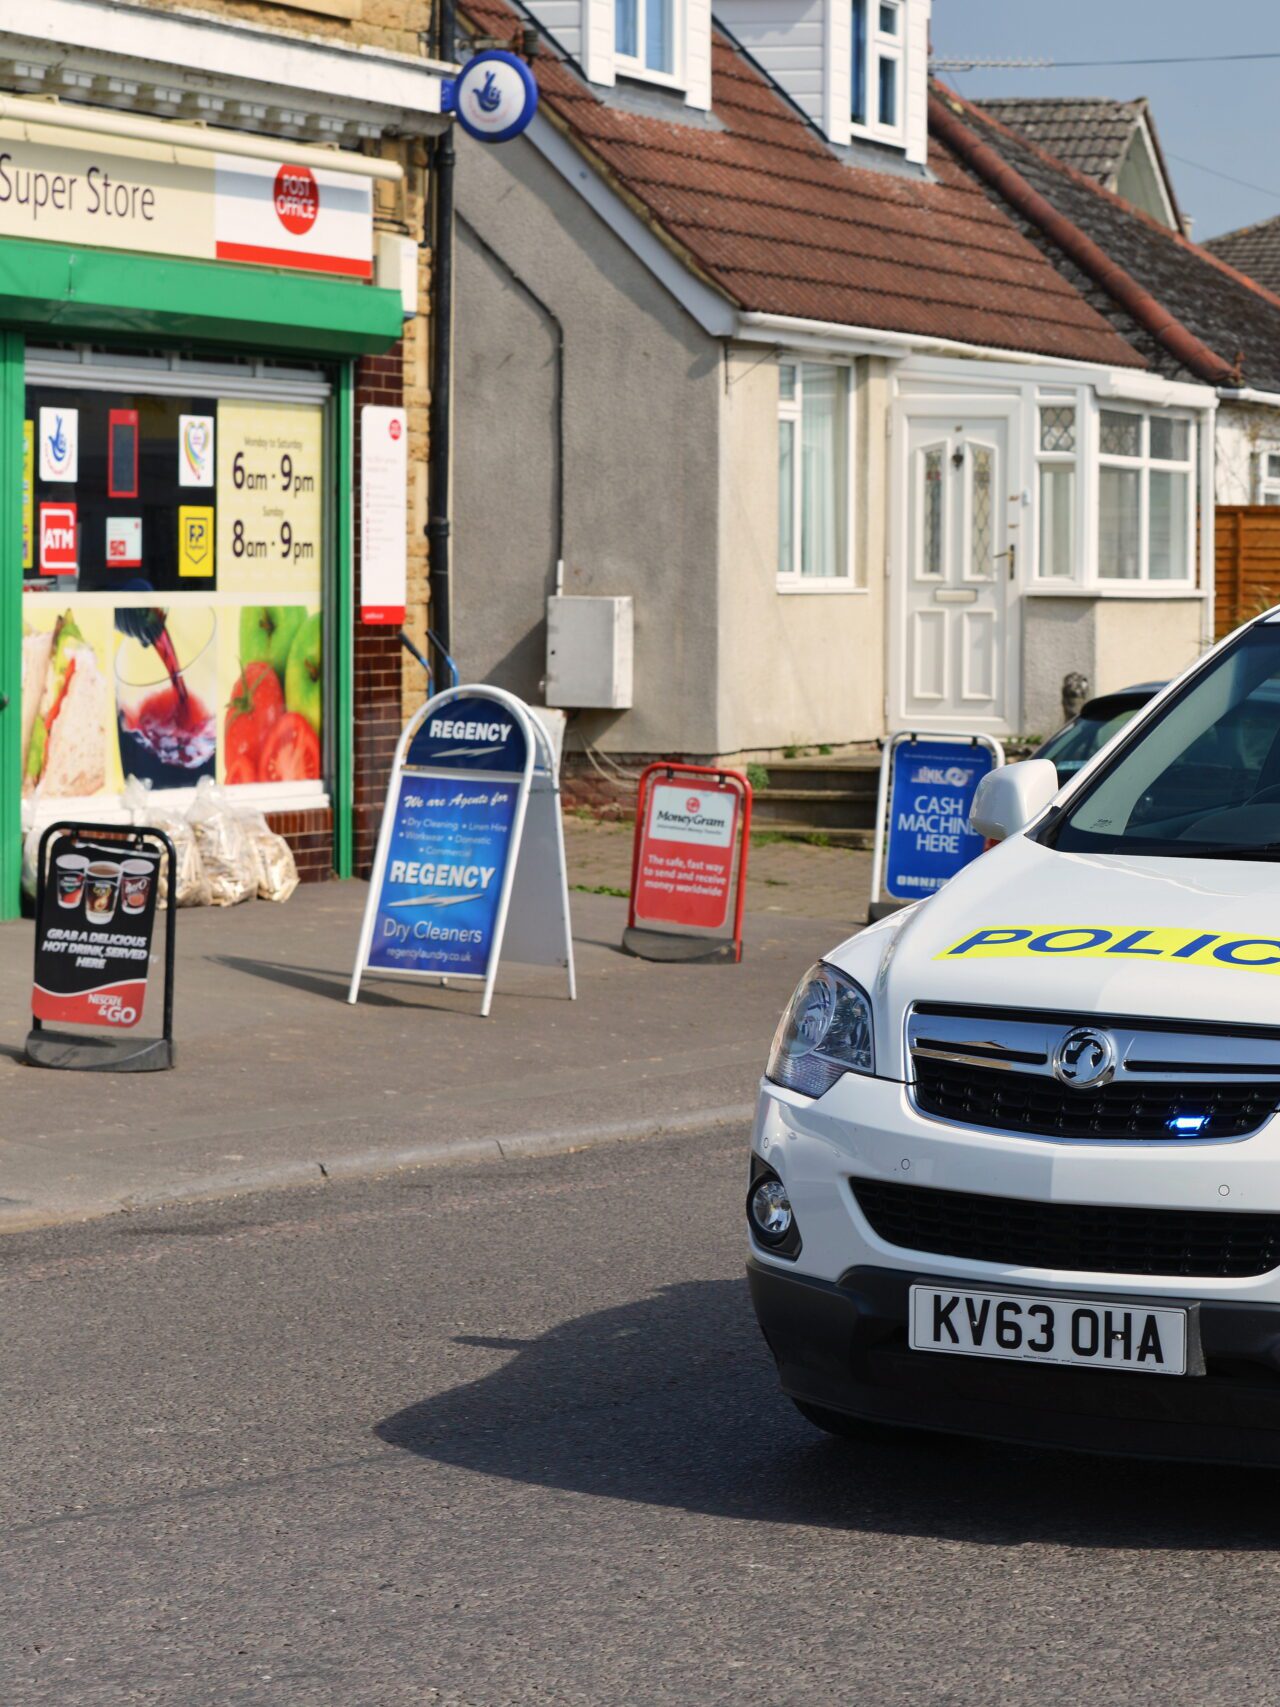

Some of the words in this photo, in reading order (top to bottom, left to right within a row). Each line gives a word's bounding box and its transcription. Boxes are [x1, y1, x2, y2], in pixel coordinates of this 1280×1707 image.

[0, 153, 77, 220] Super
[87, 166, 155, 221] Store
[282, 174, 311, 197] POST
[276, 194, 315, 219] OFFICE
[232, 451, 268, 491] 6am
[280, 454, 315, 499] 9pm
[44, 527, 75, 550] ATM
[232, 520, 268, 558] 8am
[280, 521, 314, 566] 9pm
[428, 719, 512, 742] REGENCY
[403, 795, 424, 808] We
[426, 798, 447, 807] are
[449, 793, 489, 808] Agents
[490, 792, 509, 807] for
[914, 795, 964, 815] CASH
[407, 817, 422, 828] Dry
[423, 818, 459, 831] Cleaning
[657, 810, 725, 828] MoneyGram
[915, 833, 960, 854] HERE
[389, 860, 496, 889] REGENCY
[648, 854, 665, 866] The
[665, 856, 686, 869] safe,
[687, 858, 705, 870] fast
[705, 863, 725, 875] way
[643, 866, 654, 876] to
[654, 868, 676, 880] send
[677, 870, 695, 882] and
[695, 874, 727, 885] receive
[644, 880, 675, 894] money
[675, 883, 723, 897] worldwide
[47, 928, 80, 940] GRAB
[78, 931, 88, 942] A
[89, 931, 147, 947] DELICIOUS
[384, 918, 410, 943] Dry
[413, 920, 483, 944] Cleaners
[42, 940, 69, 953] HOT
[104, 946, 148, 960] SERVED
[75, 957, 107, 969] HERE
[932, 1295, 1056, 1353] KV63
[1071, 1306, 1165, 1365] OHA
